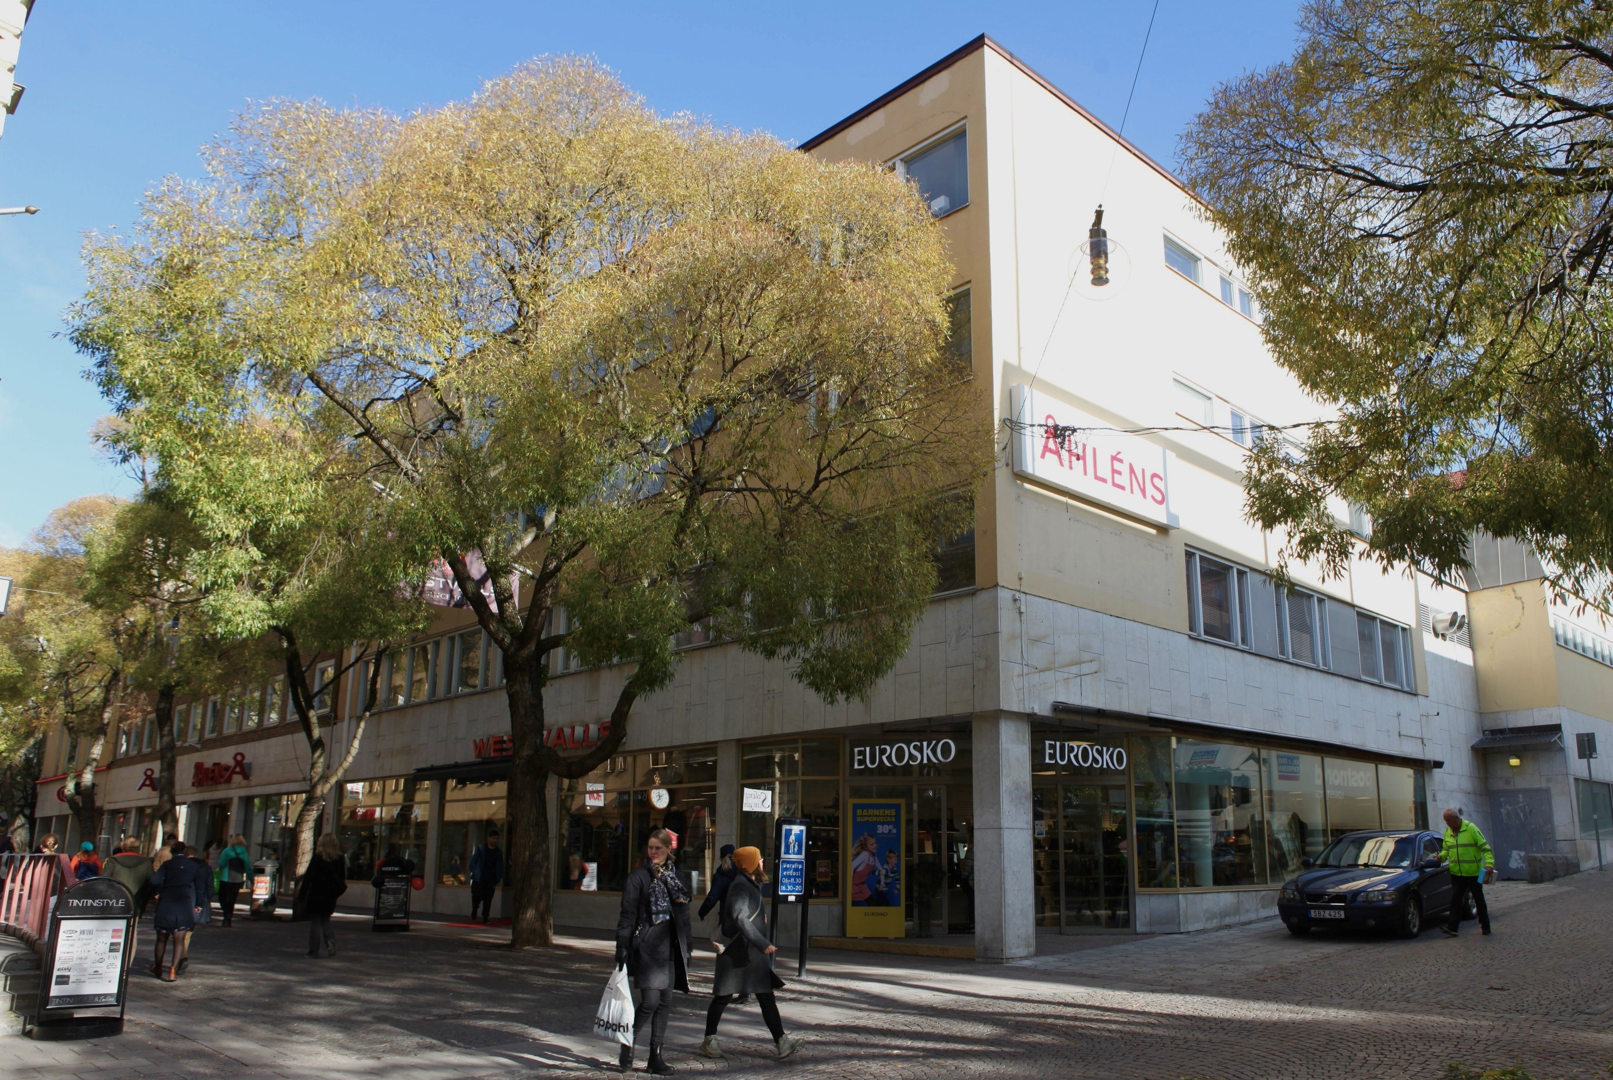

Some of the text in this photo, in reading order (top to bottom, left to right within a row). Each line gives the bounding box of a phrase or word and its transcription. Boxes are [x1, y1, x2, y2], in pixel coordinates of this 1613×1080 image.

[1040, 414, 1166, 506] ÅHLÉNS
[853, 738, 956, 770] EUROSKO
[1044, 740, 1127, 770] EUROSKO
[876, 825, 897, 834] 30%
[68, 899, 126, 907] TINTINSTYLE
[594, 1017, 629, 1033] appahl
